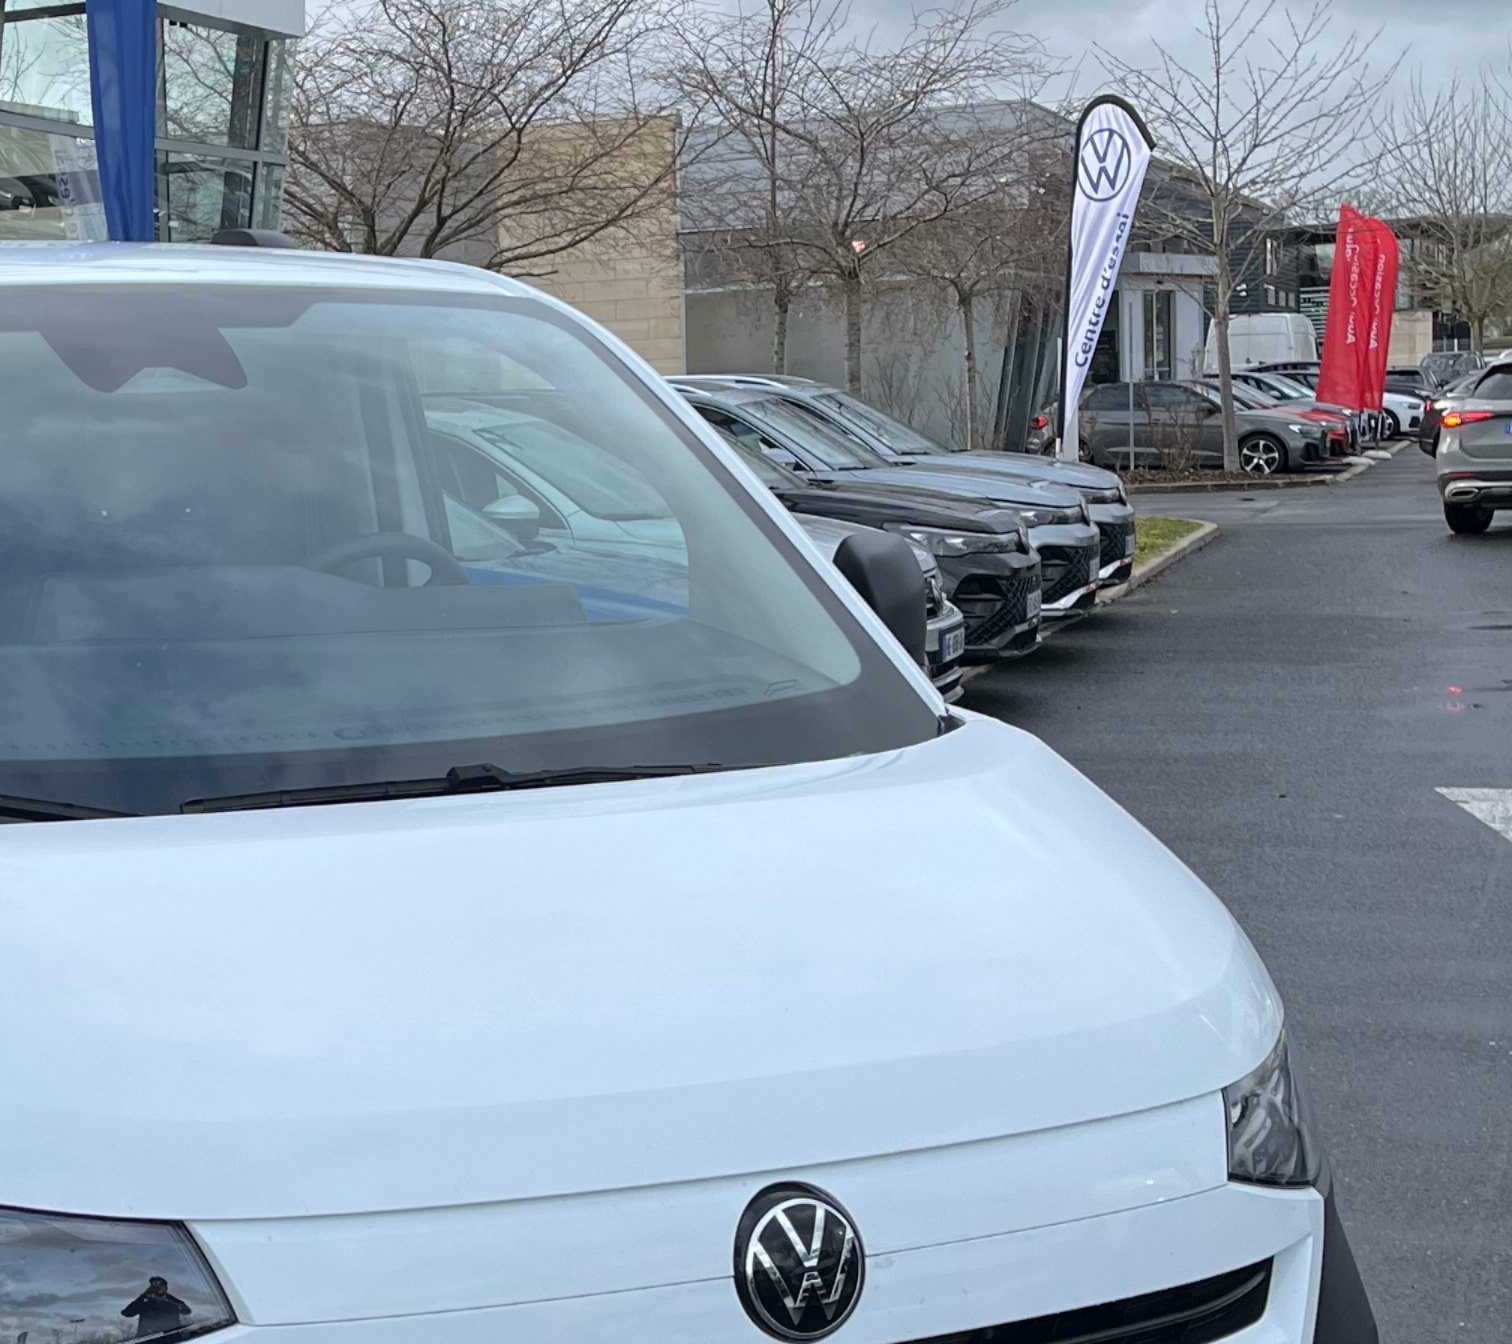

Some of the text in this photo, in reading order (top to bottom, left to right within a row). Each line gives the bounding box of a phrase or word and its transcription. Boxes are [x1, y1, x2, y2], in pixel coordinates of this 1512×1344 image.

[1078, 128, 1131, 202] VW
[1075, 295, 1107, 369] Centre
[745, 1197, 862, 1339] VW
